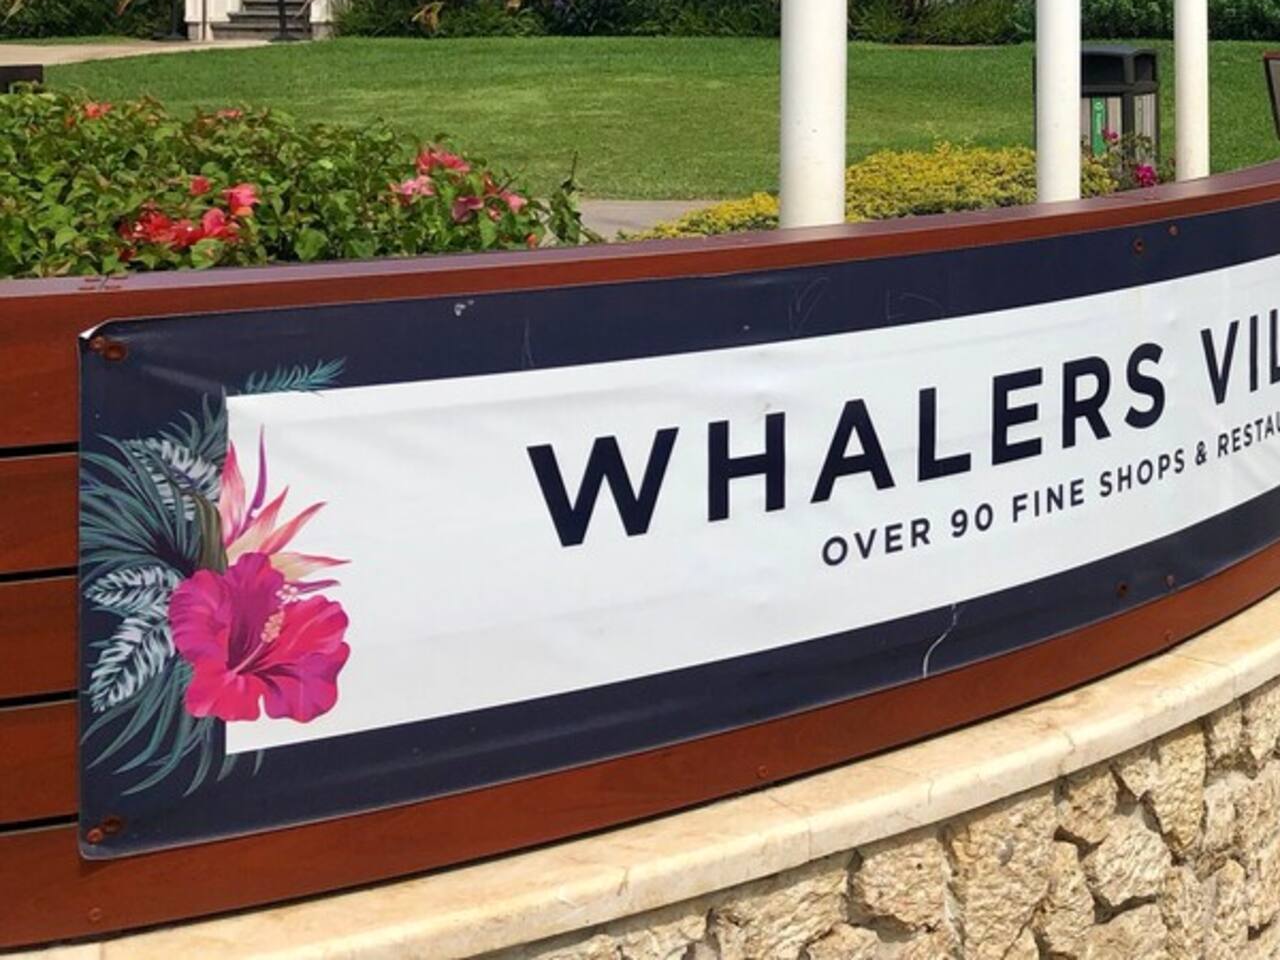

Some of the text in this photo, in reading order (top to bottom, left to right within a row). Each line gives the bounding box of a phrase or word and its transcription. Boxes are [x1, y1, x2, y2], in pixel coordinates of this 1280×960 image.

[527, 342, 1166, 548] WHALERS
[822, 518, 930, 567] OVER
[951, 503, 993, 538] 90
[1012, 478, 1084, 523] FINE
[1100, 448, 1186, 498] SHOPS
[1195, 441, 1208, 466] &
